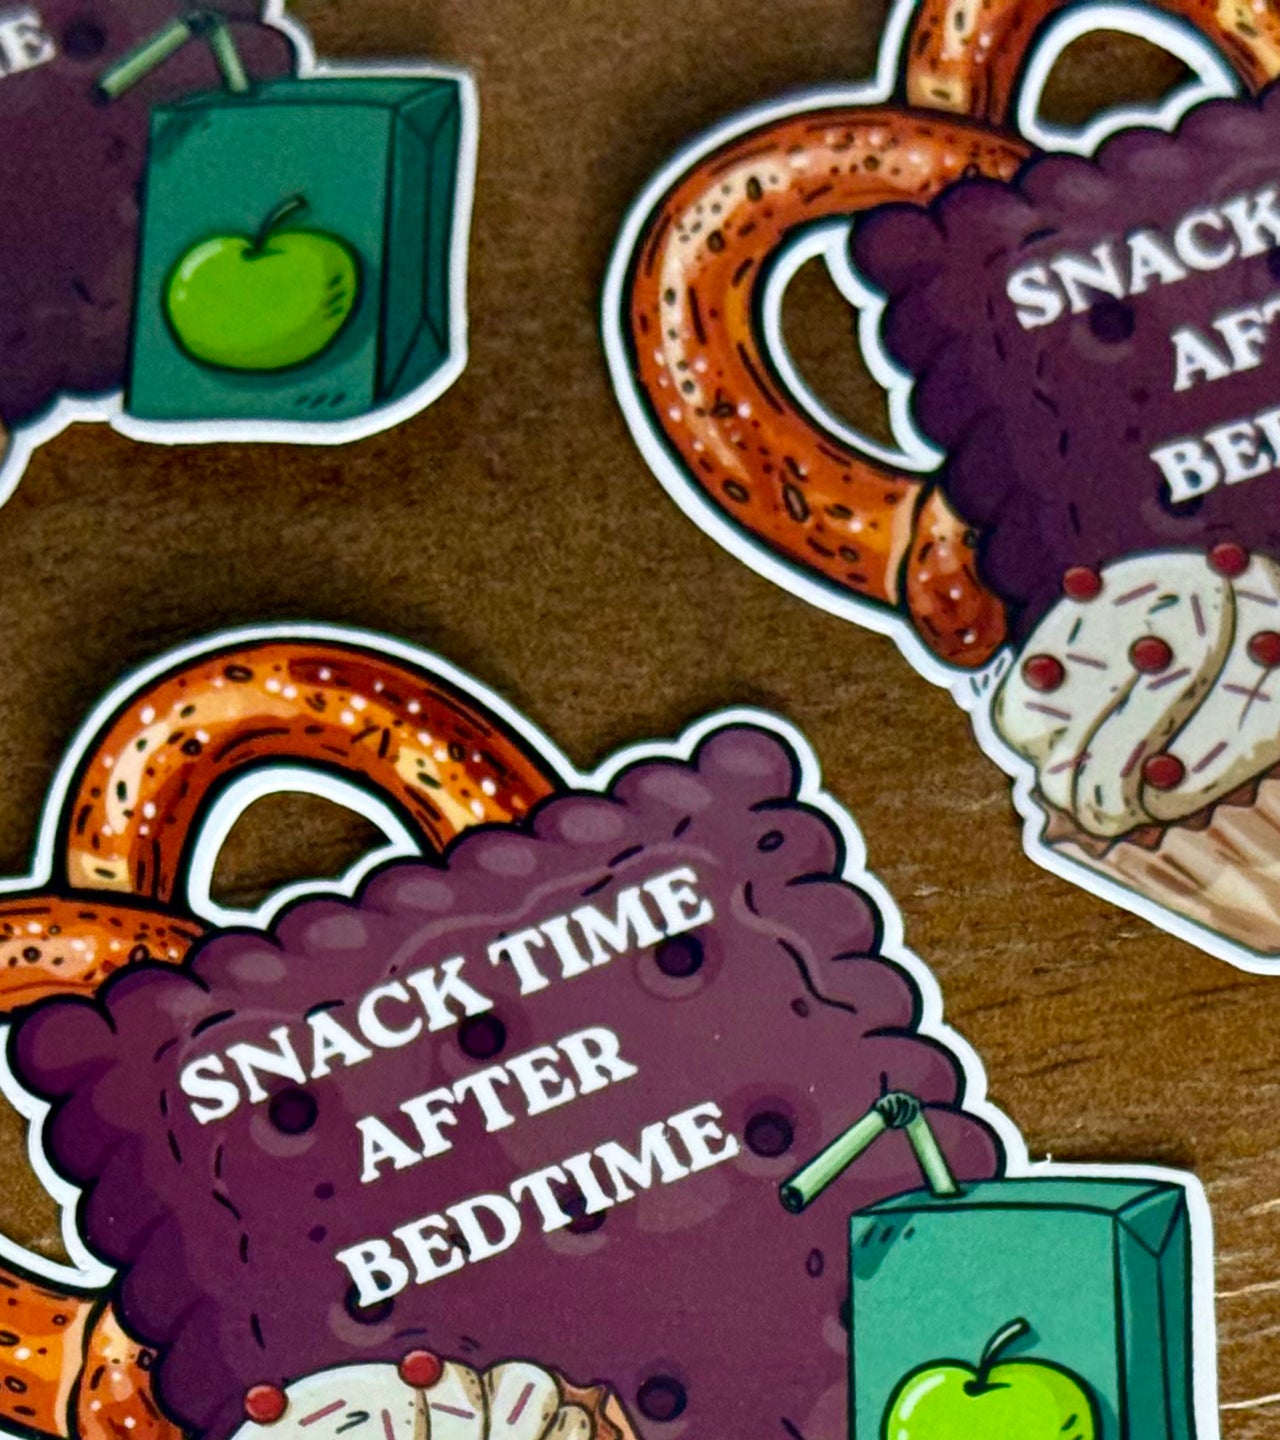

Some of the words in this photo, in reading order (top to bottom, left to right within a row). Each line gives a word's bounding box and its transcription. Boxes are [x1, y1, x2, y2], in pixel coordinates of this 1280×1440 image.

[178, 954, 495, 1126] SNACK
[485, 865, 716, 997] TIME
[334, 1100, 743, 1309] BEDTIME
[354, 1025, 640, 1185] AFTER
